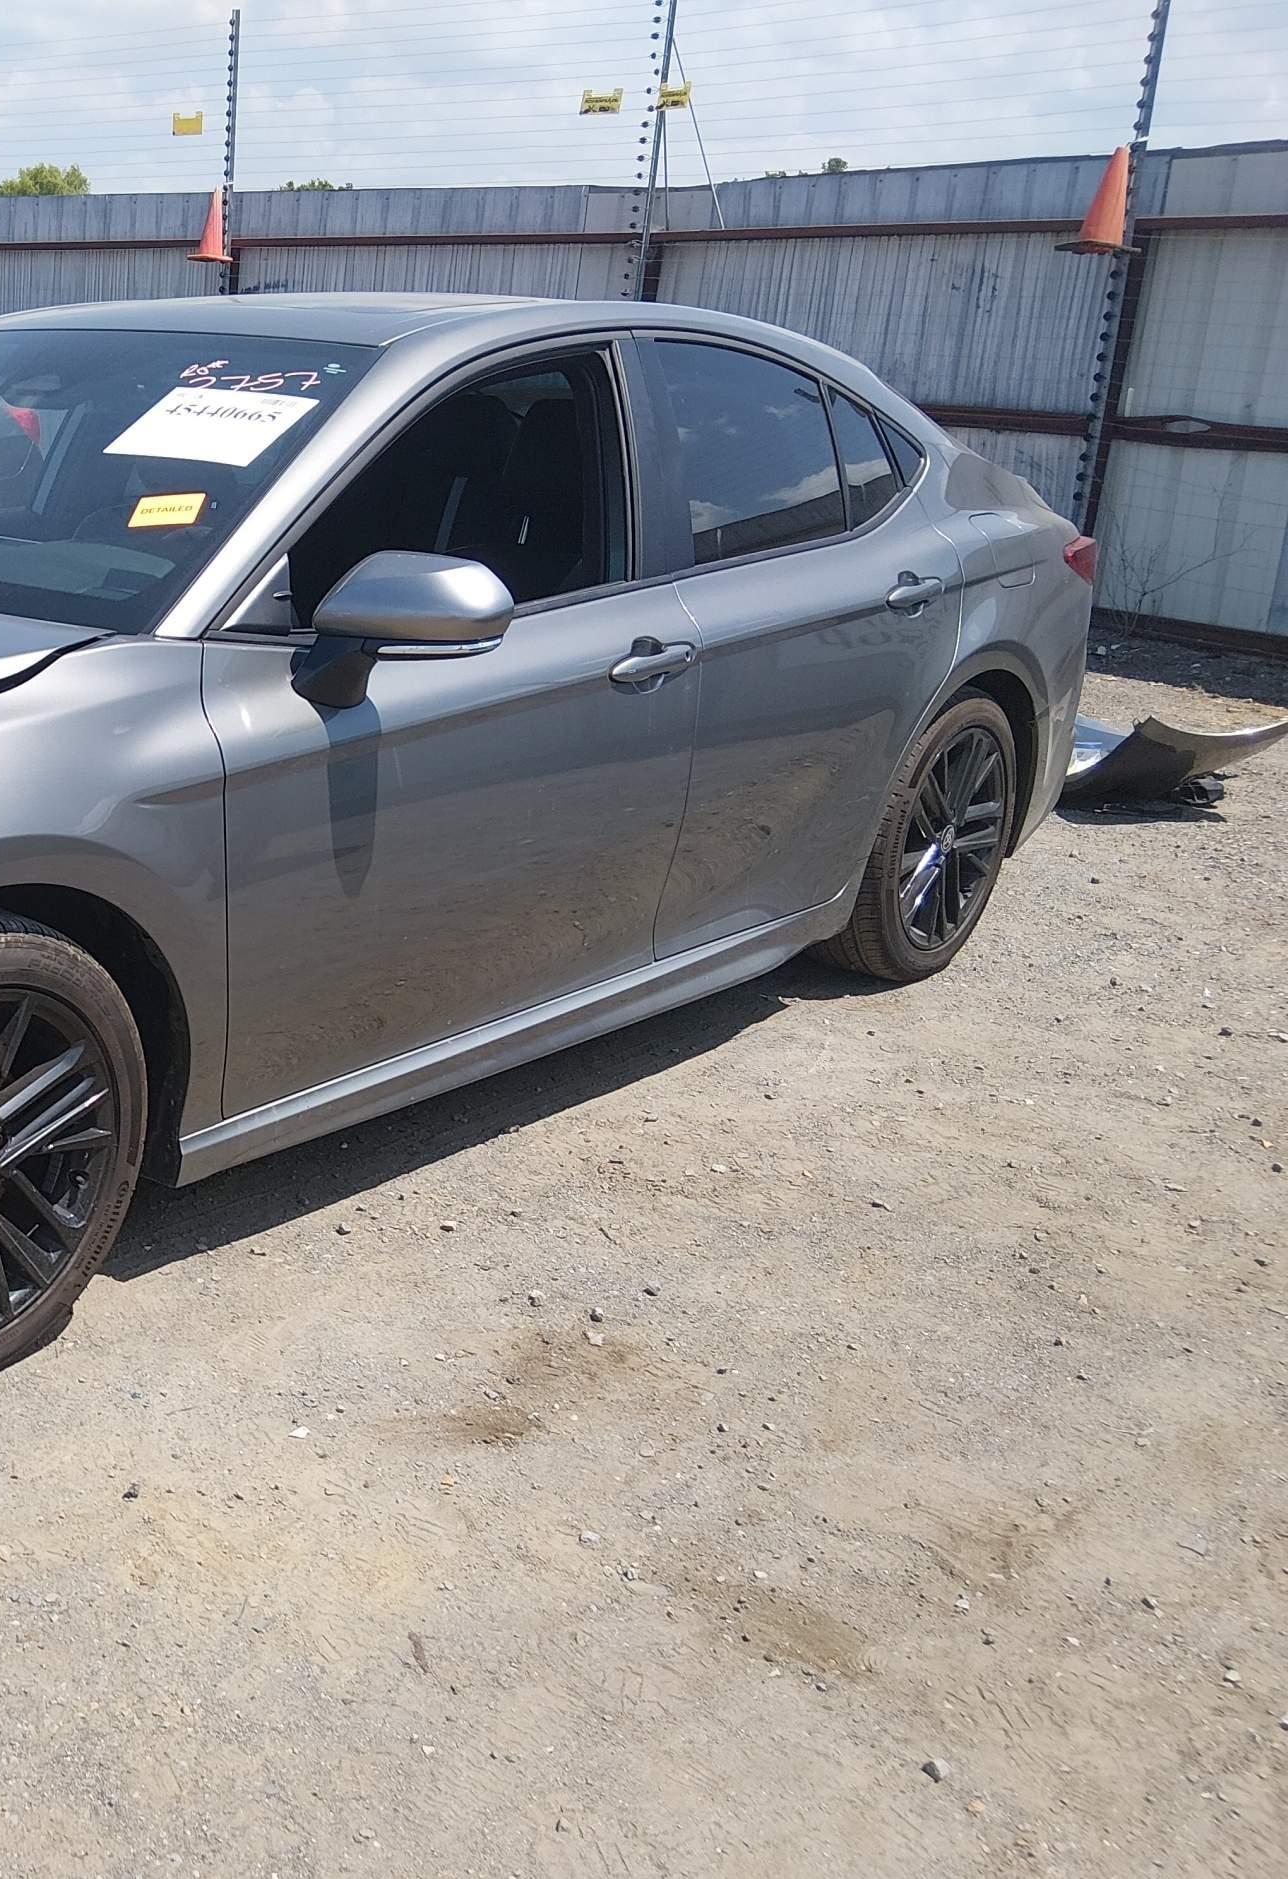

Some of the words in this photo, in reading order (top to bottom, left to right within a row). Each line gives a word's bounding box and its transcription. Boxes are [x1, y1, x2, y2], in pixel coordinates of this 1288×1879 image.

[140, 505, 193, 514] DETAILED
[888, 808, 907, 878] Continental
[81, 1181, 130, 1277] Continental
